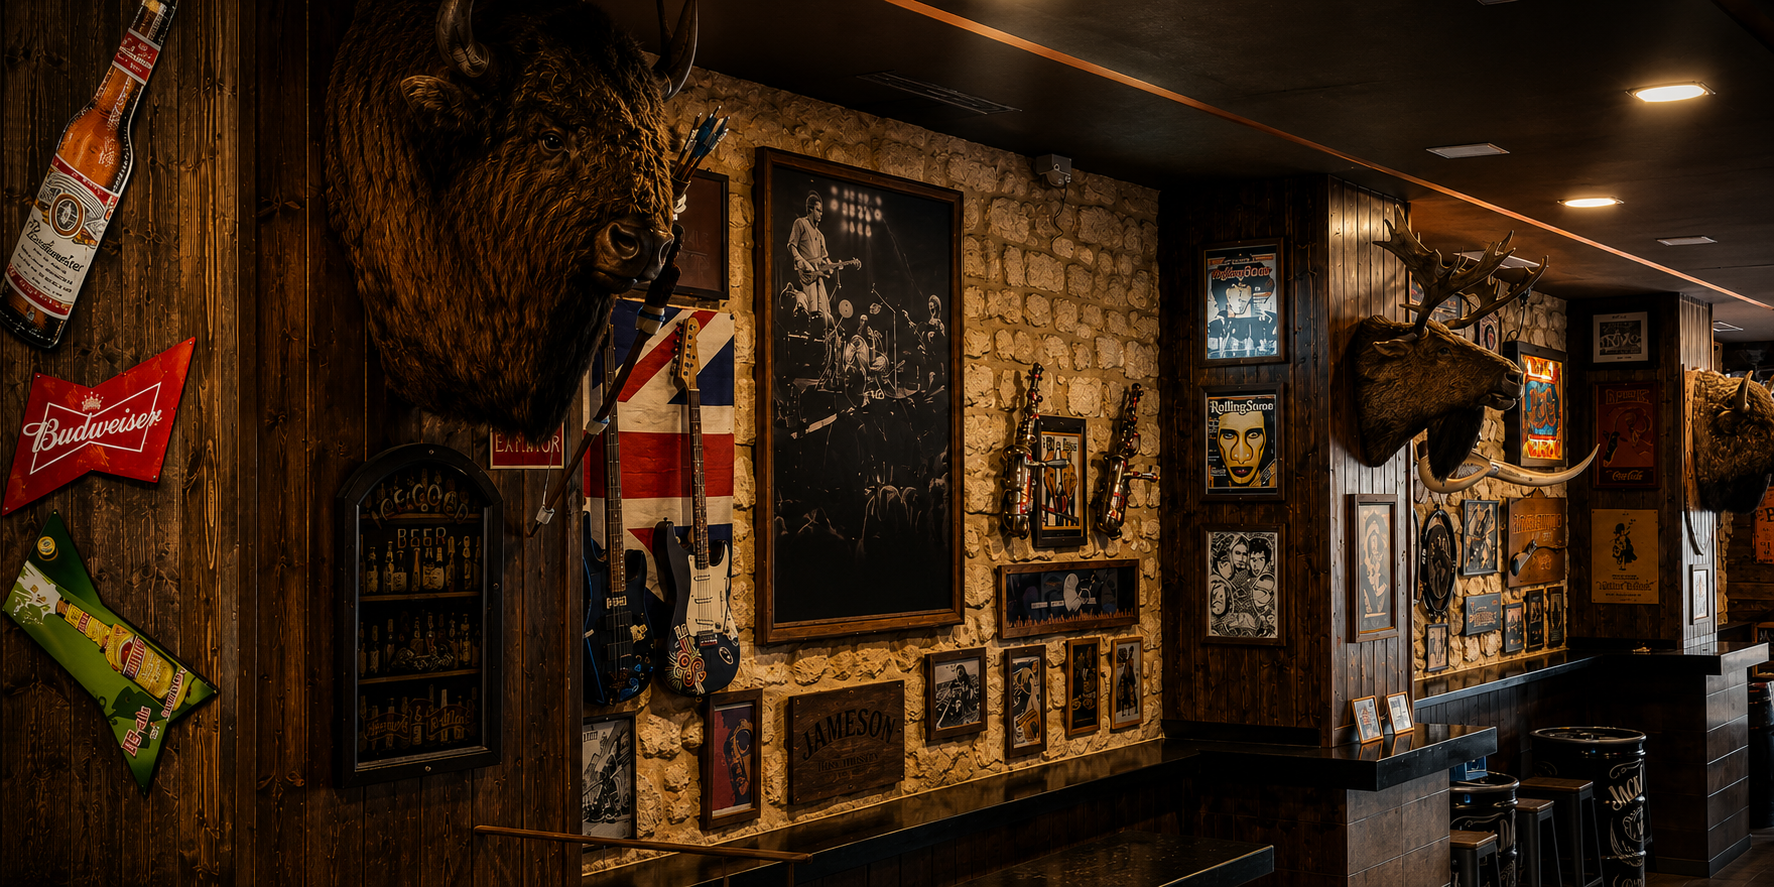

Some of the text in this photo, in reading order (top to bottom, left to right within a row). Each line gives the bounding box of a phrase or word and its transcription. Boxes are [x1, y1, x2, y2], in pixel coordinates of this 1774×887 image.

[23, 413, 162, 453] Budweiser
[397, 527, 447, 549] BEER
[802, 708, 896, 761] JAMESON
